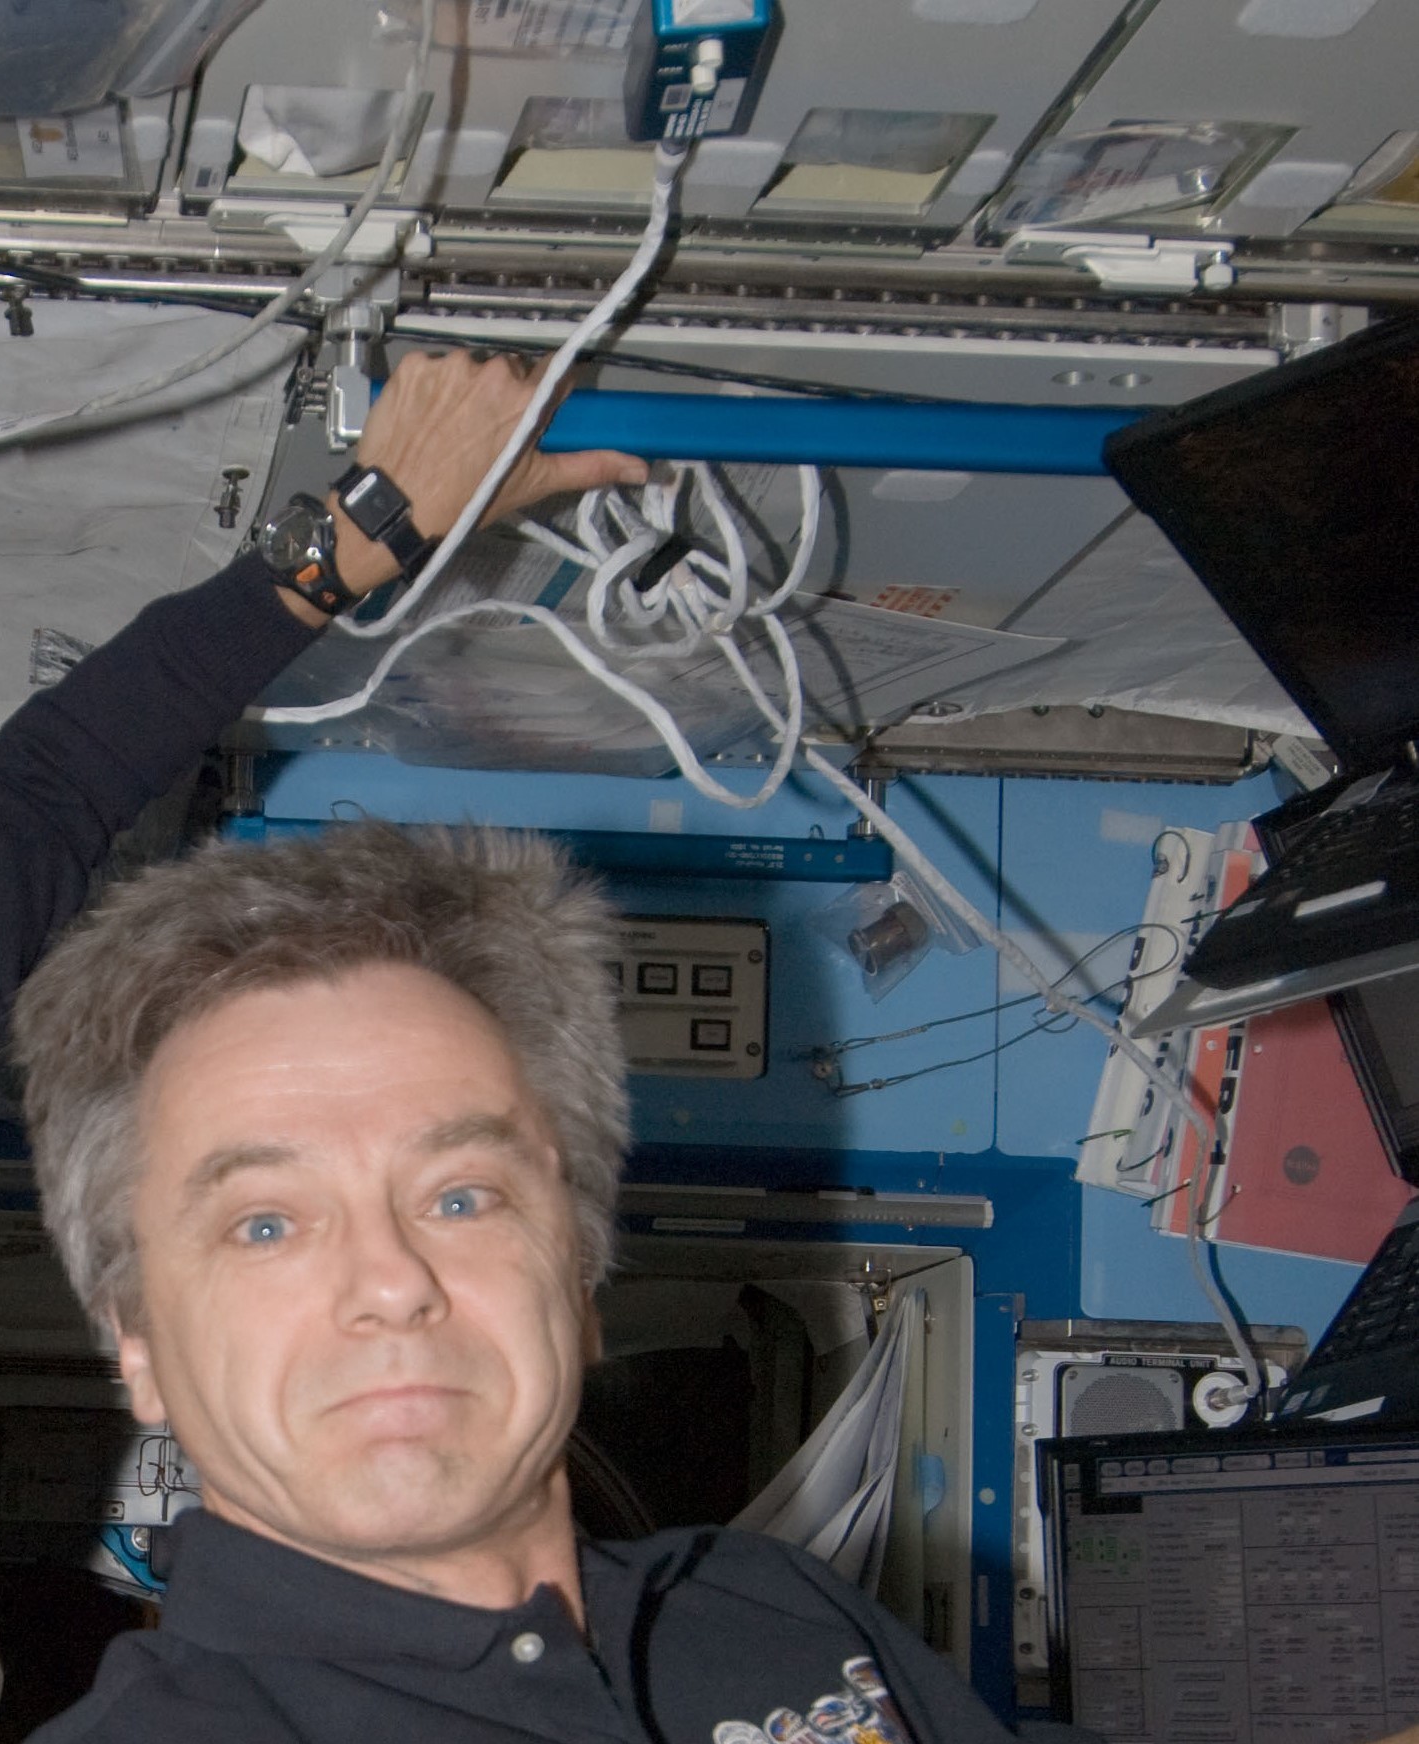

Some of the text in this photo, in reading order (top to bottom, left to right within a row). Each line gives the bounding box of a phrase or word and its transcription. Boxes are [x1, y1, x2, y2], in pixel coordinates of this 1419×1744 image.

[1108, 1357, 1212, 1368] AUDIO TERMINAL UNIT
